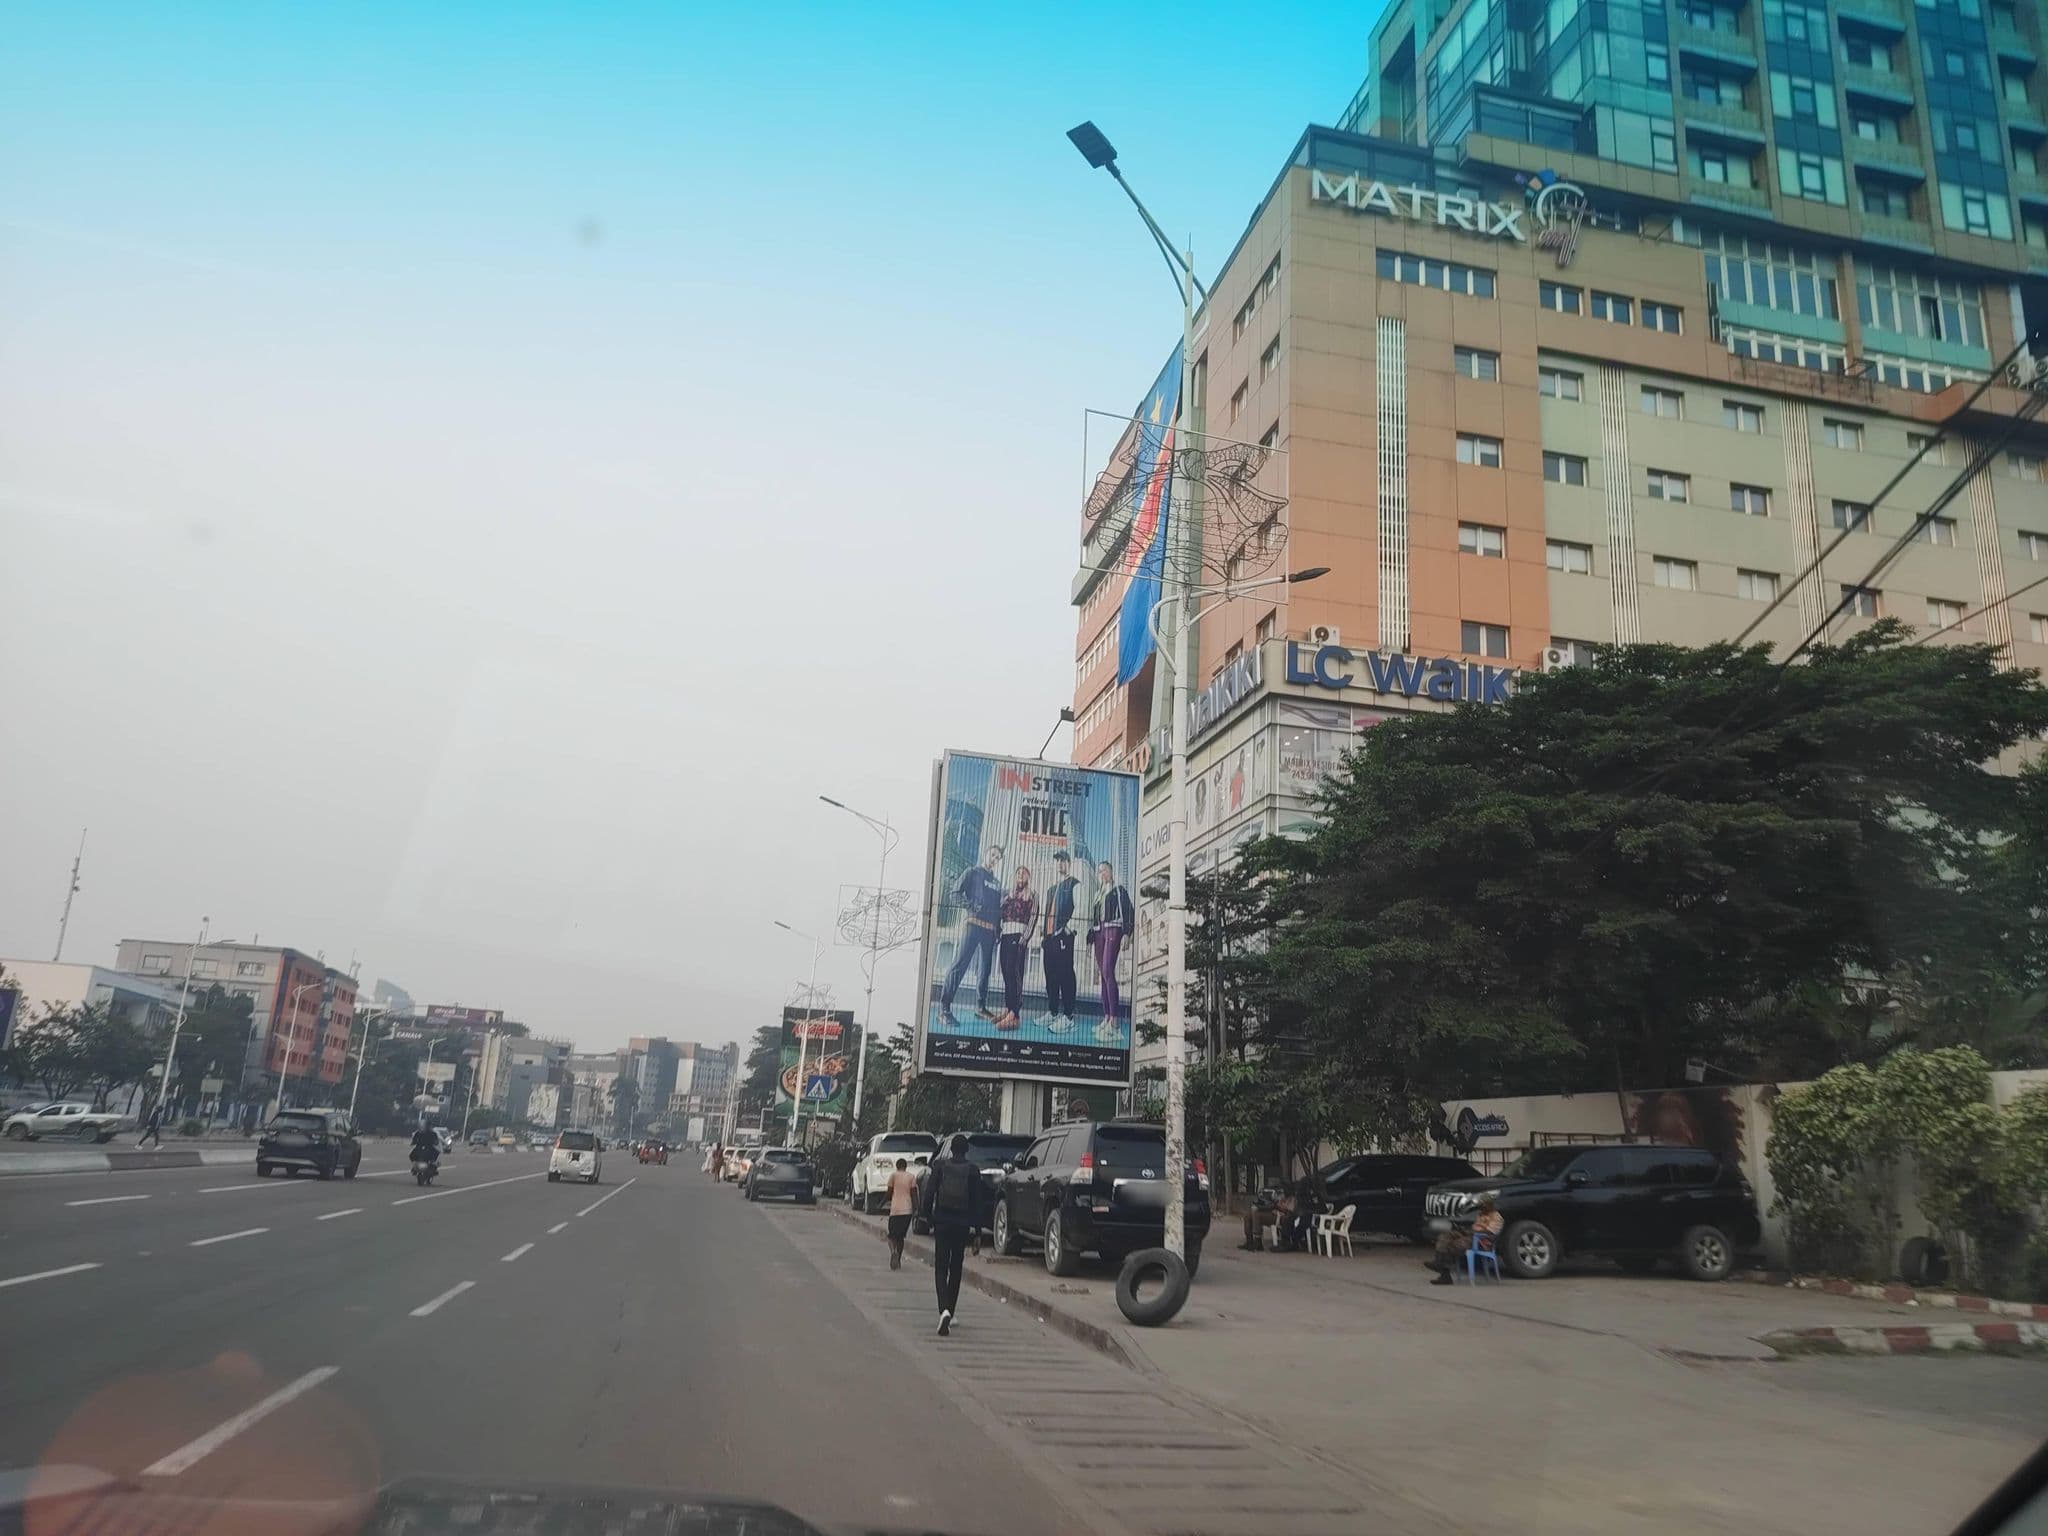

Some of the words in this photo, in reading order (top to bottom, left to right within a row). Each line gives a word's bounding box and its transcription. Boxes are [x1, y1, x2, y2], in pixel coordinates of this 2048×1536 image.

[1311, 169, 1525, 241] MATRIX
[1285, 640, 1354, 689] LC
[999, 767, 1032, 793] IN
[1032, 776, 1092, 797] STREET
[1020, 806, 1068, 836] STYLE
